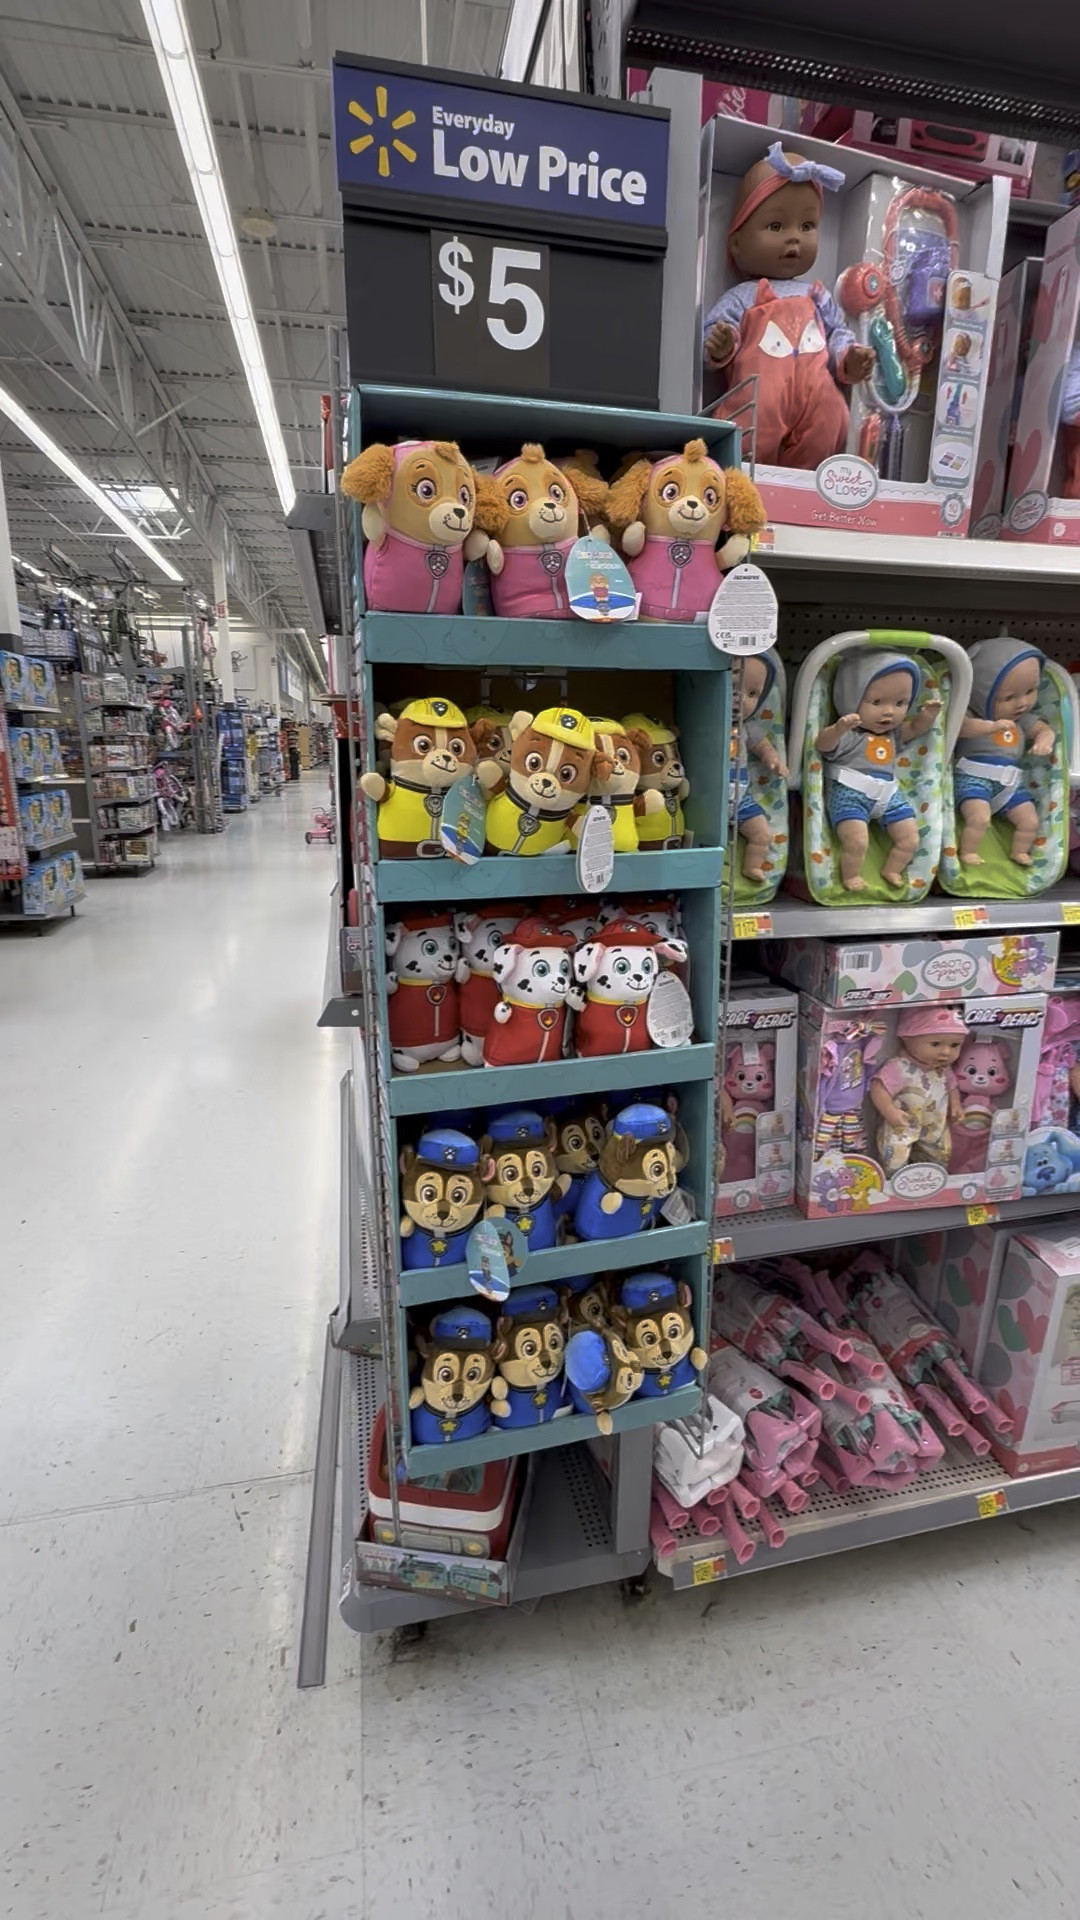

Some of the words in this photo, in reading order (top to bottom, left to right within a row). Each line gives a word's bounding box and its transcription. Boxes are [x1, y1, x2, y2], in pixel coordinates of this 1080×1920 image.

[432, 106, 515, 140] Everyday
[433, 129, 529, 187] Low
[538, 145, 647, 205] Price
[824, 469, 873, 491] Sweet
[811, 509, 827, 522] Get
[829, 511, 856, 525] Better
[857, 515, 878, 526] Now
[754, 1012, 794, 1028] BEARS
[965, 1008, 999, 1024] CARE
[1000, 1011, 1044, 1028] BEARS
